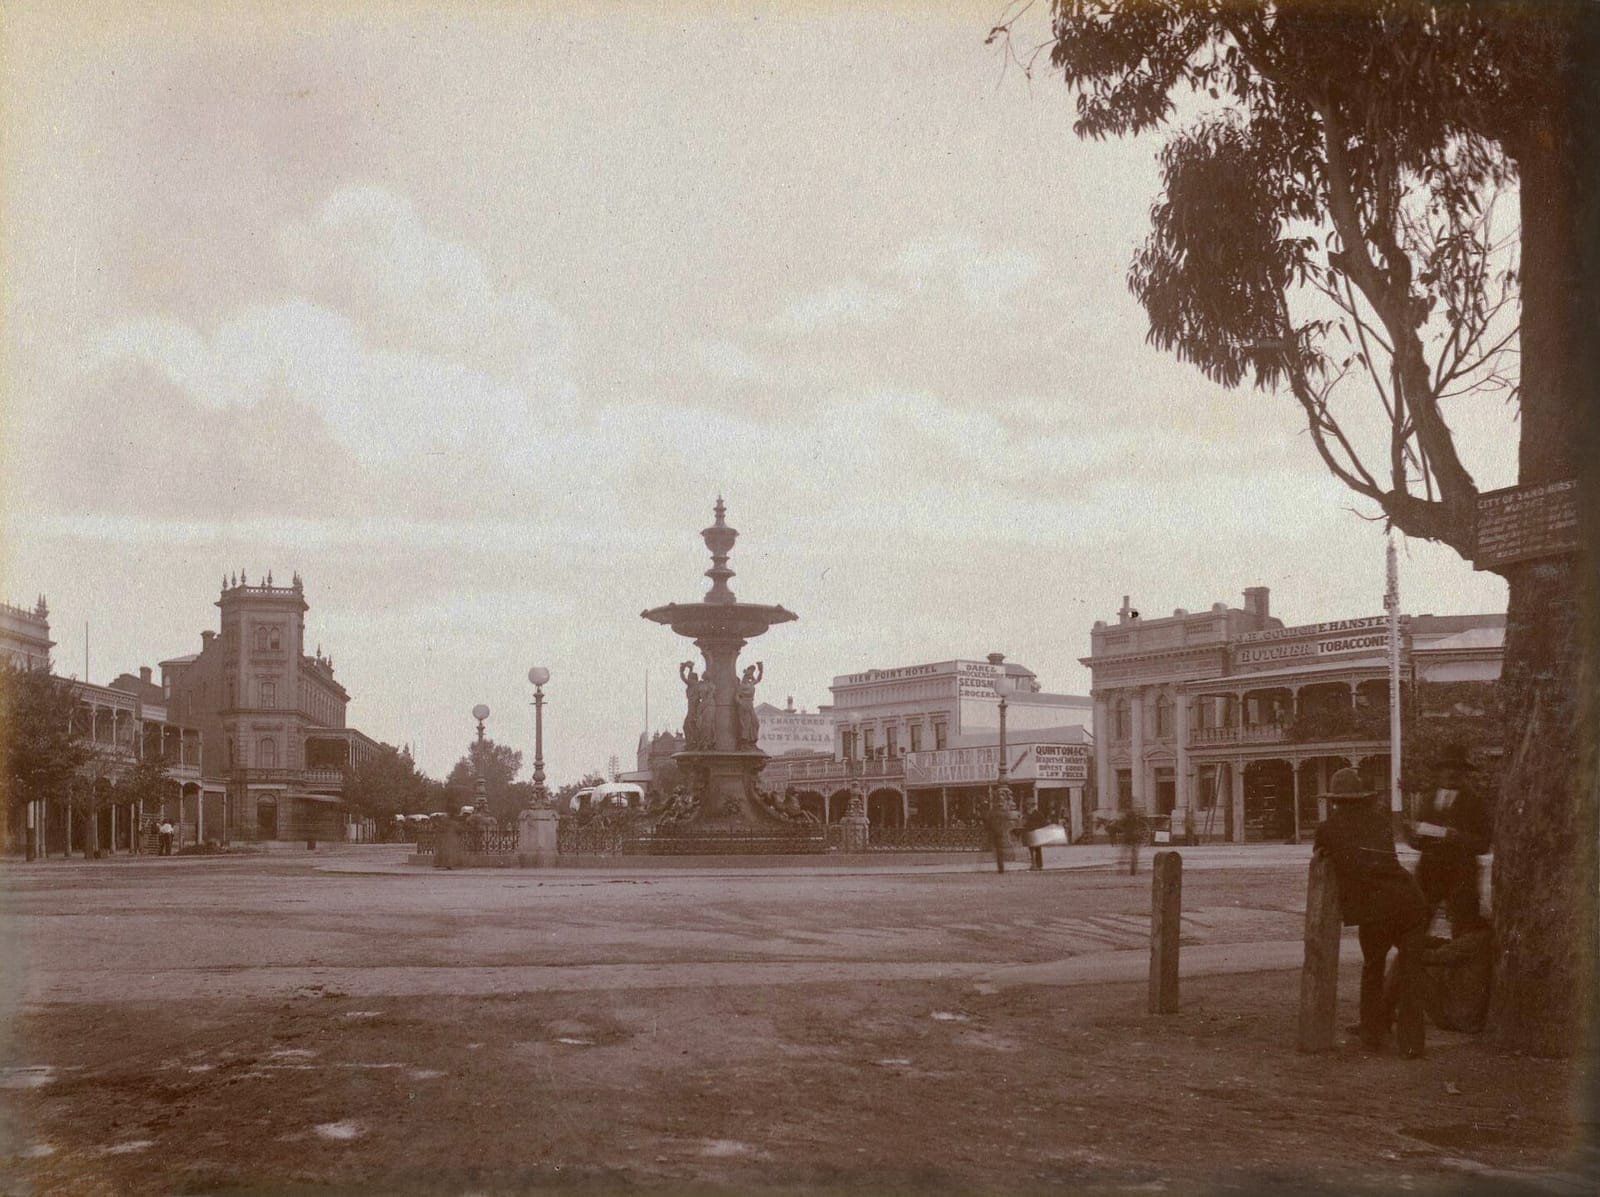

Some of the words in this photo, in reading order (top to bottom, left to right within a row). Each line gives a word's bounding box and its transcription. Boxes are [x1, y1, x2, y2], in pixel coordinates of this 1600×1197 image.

[1478, 498, 1501, 509] CITY
[1502, 494, 1513, 504] OF
[1329, 616, 1391, 632] HANSTE
[1318, 636, 1391, 653] TOBACCONIS
[848, 673, 871, 683] VIEW
[875, 669, 902, 681] POINT
[905, 665, 937, 676] HOTEL
[959, 678, 994, 688] SEEDSM
